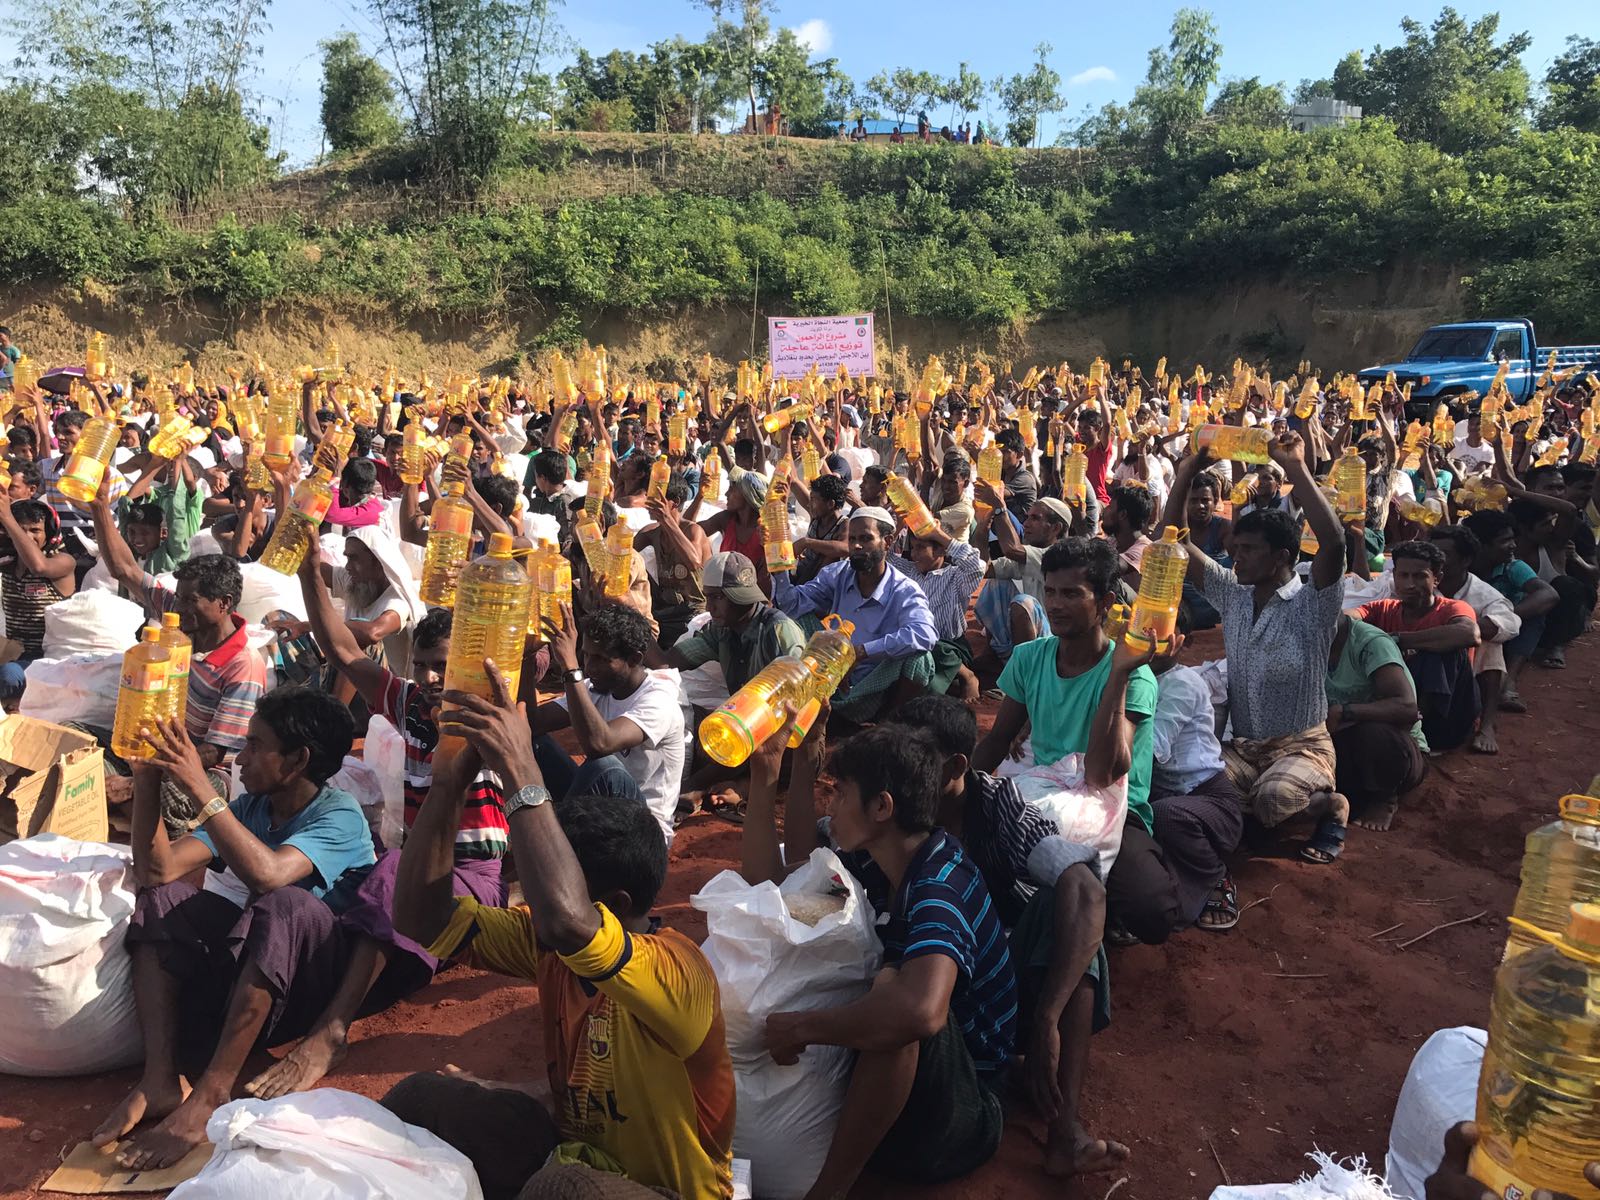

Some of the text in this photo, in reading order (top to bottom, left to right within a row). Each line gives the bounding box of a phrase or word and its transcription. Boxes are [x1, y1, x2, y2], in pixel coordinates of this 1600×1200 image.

[838, 341, 863, 352] توزيع
[64, 773, 95, 802] Family
[58, 793, 91, 817] VEGETABLE
